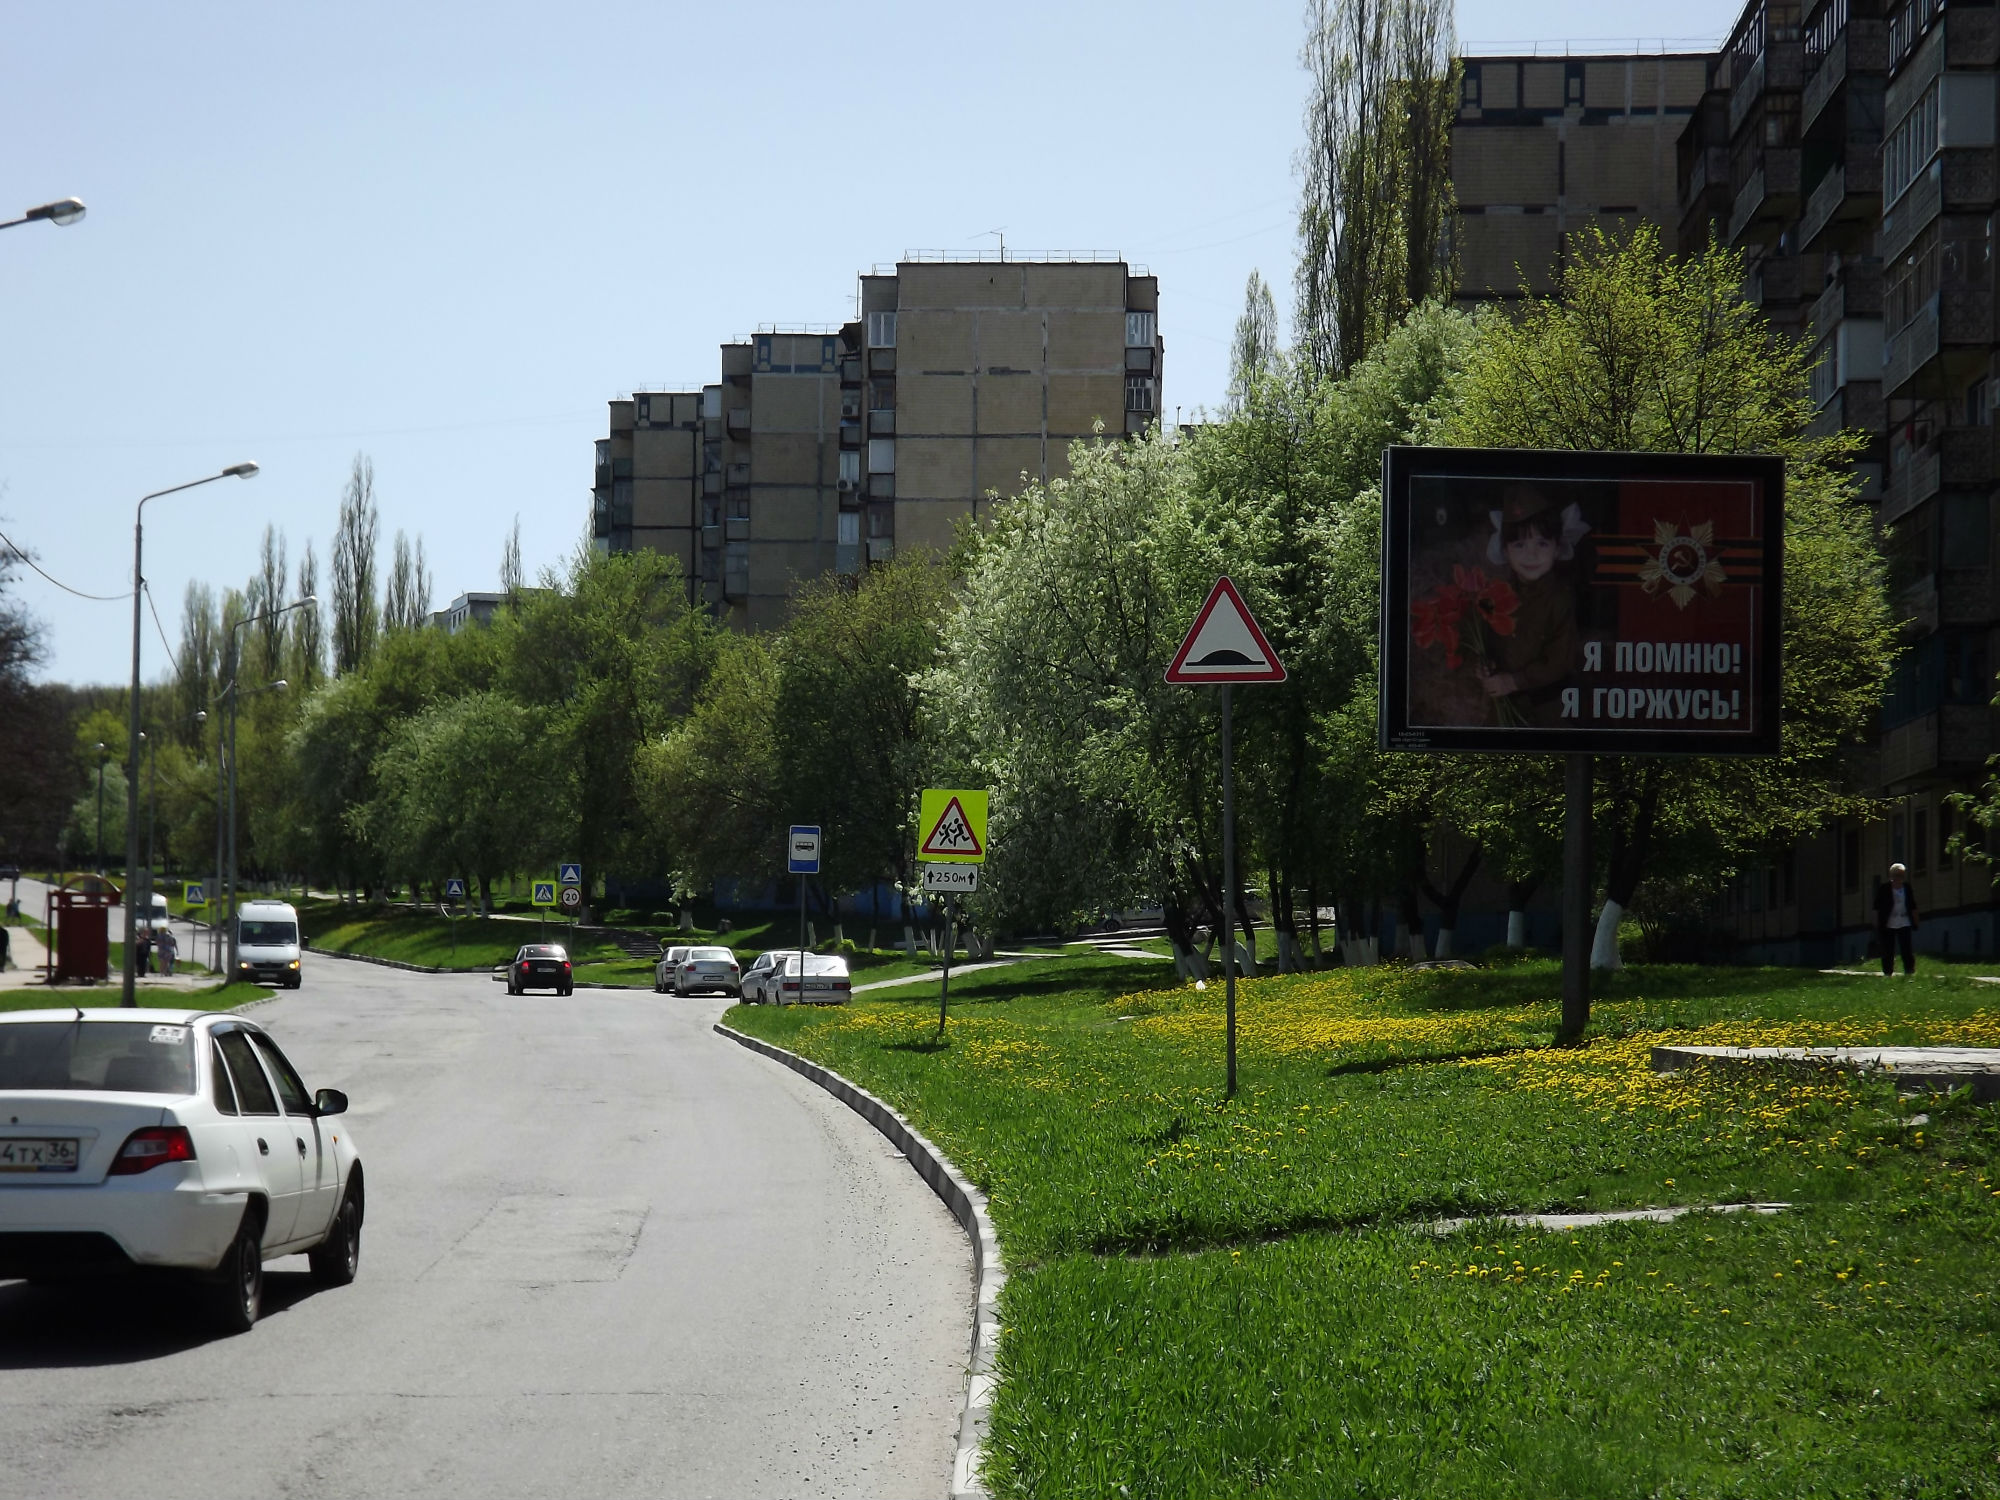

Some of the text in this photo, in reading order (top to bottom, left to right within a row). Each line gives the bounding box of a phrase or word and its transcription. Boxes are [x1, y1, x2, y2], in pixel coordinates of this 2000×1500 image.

[1583, 641, 1740, 674] Я ПОМНЮ!
[1560, 687, 1740, 720] Я ГОРЖУСЬ!
[936, 871, 966, 883] 250м
[566, 893, 578, 901] 20
[0, 1142, 70, 1163] 4ТХ 36
